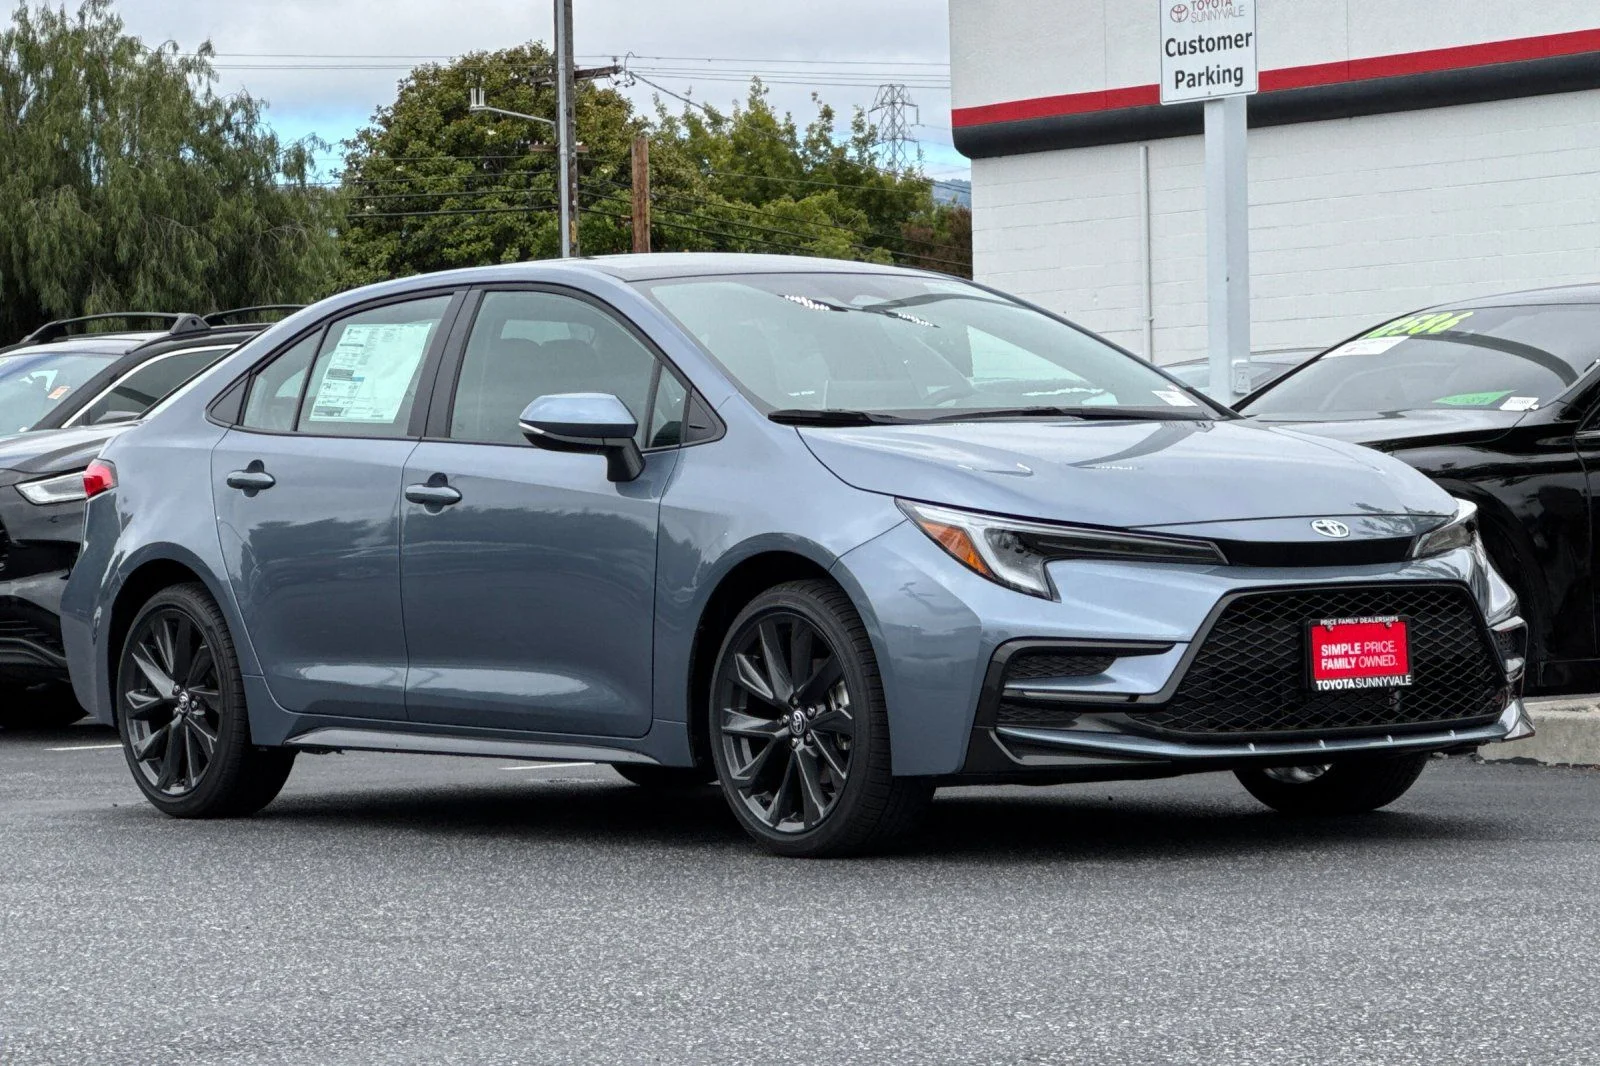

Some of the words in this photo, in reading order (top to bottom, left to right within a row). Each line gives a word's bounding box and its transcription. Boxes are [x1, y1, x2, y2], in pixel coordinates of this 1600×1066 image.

[1190, 0, 1233, 11] TOYOTA
[1191, 5, 1245, 23] SUNNYVALE
[1165, 32, 1253, 57] Customer
[1175, 64, 1244, 89] Parking
[1320, 618, 1337, 626] PRICE
[1338, 617, 1359, 625] FAMILY
[1360, 615, 1399, 624] DEALERSHIPS
[1321, 643, 1361, 656] SIMPLE
[1364, 641, 1397, 654] PRICE.
[1321, 657, 1357, 670] FAMILY
[1358, 655, 1398, 668] OWNED.
[1316, 679, 1355, 691] TOYOTA
[1355, 675, 1412, 688] SUNNYVALE
